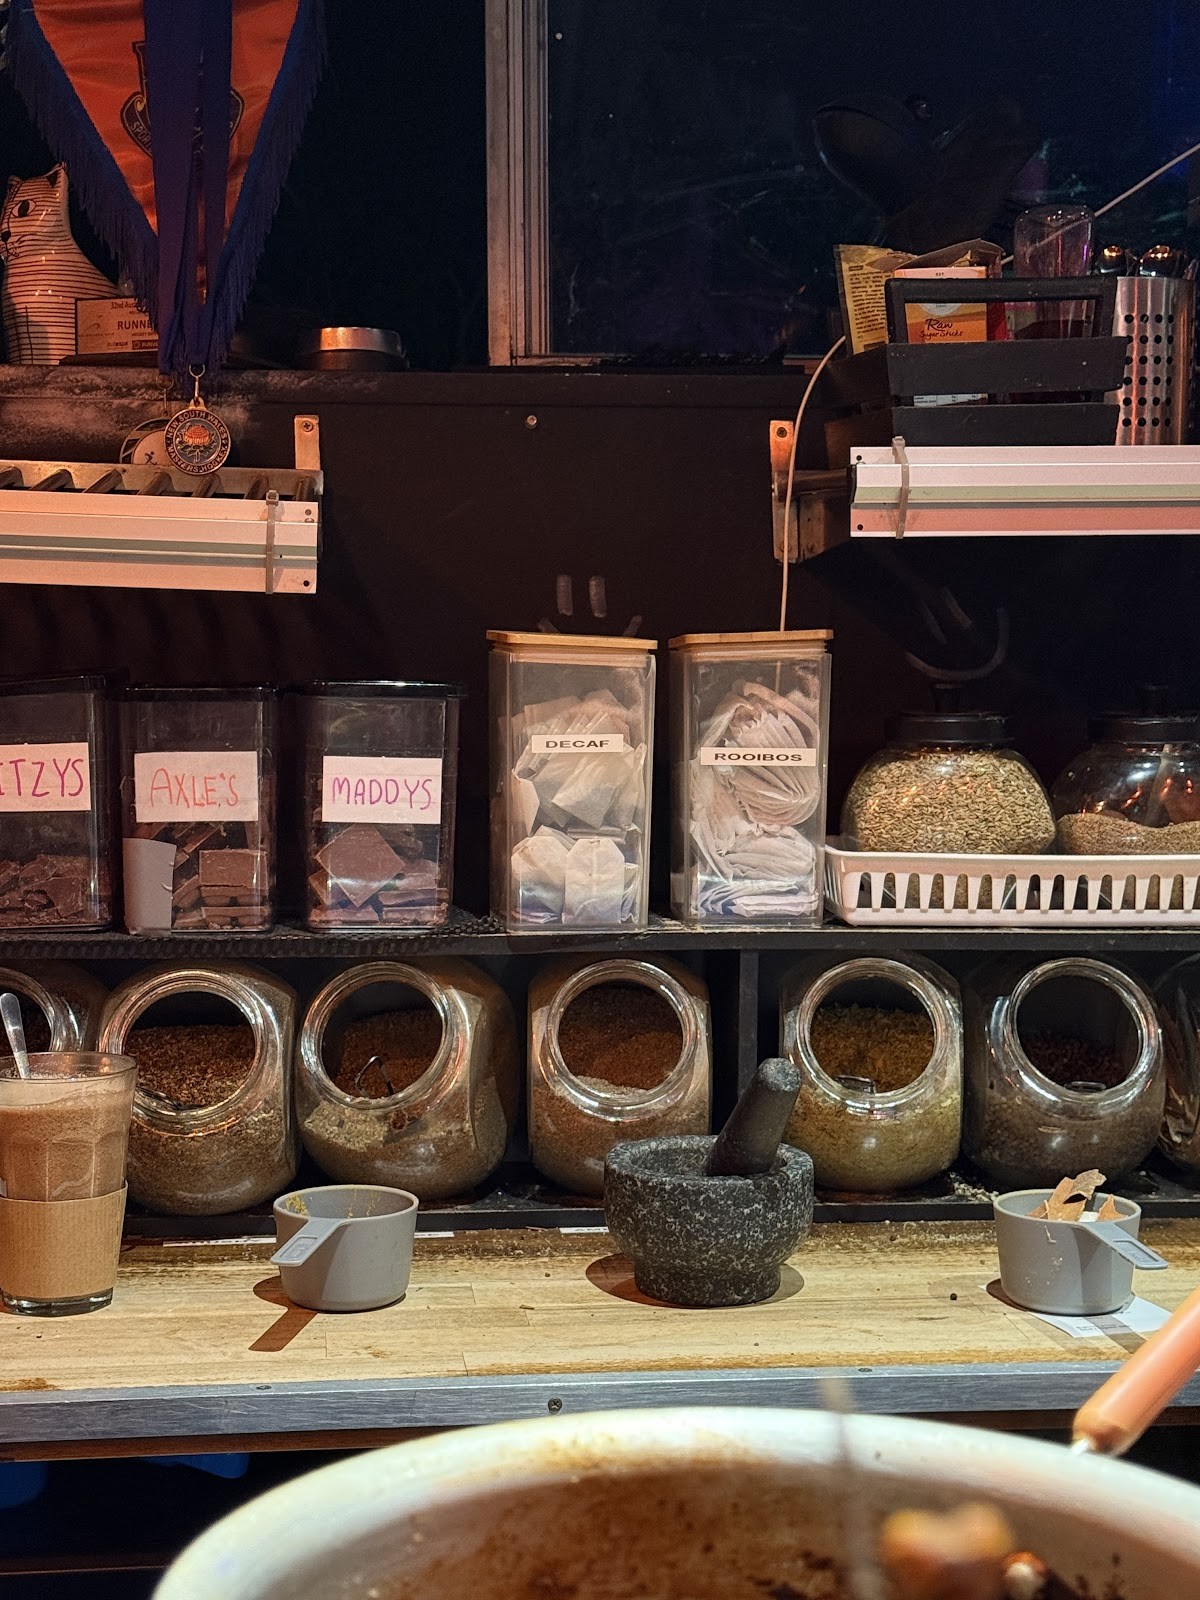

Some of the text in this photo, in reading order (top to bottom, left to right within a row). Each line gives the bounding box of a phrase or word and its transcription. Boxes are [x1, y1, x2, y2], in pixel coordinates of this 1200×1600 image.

[925, 318, 953, 332] Raw
[919, 329, 963, 341] Sugar Sticks
[167, 410, 228, 439] NEW SOUTH WALES
[167, 444, 228, 473] MASTERS HOCKEY
[545, 739, 610, 749] DECAF
[713, 752, 803, 762] ROOIBOS
[332, 777, 432, 810] MADDYS
